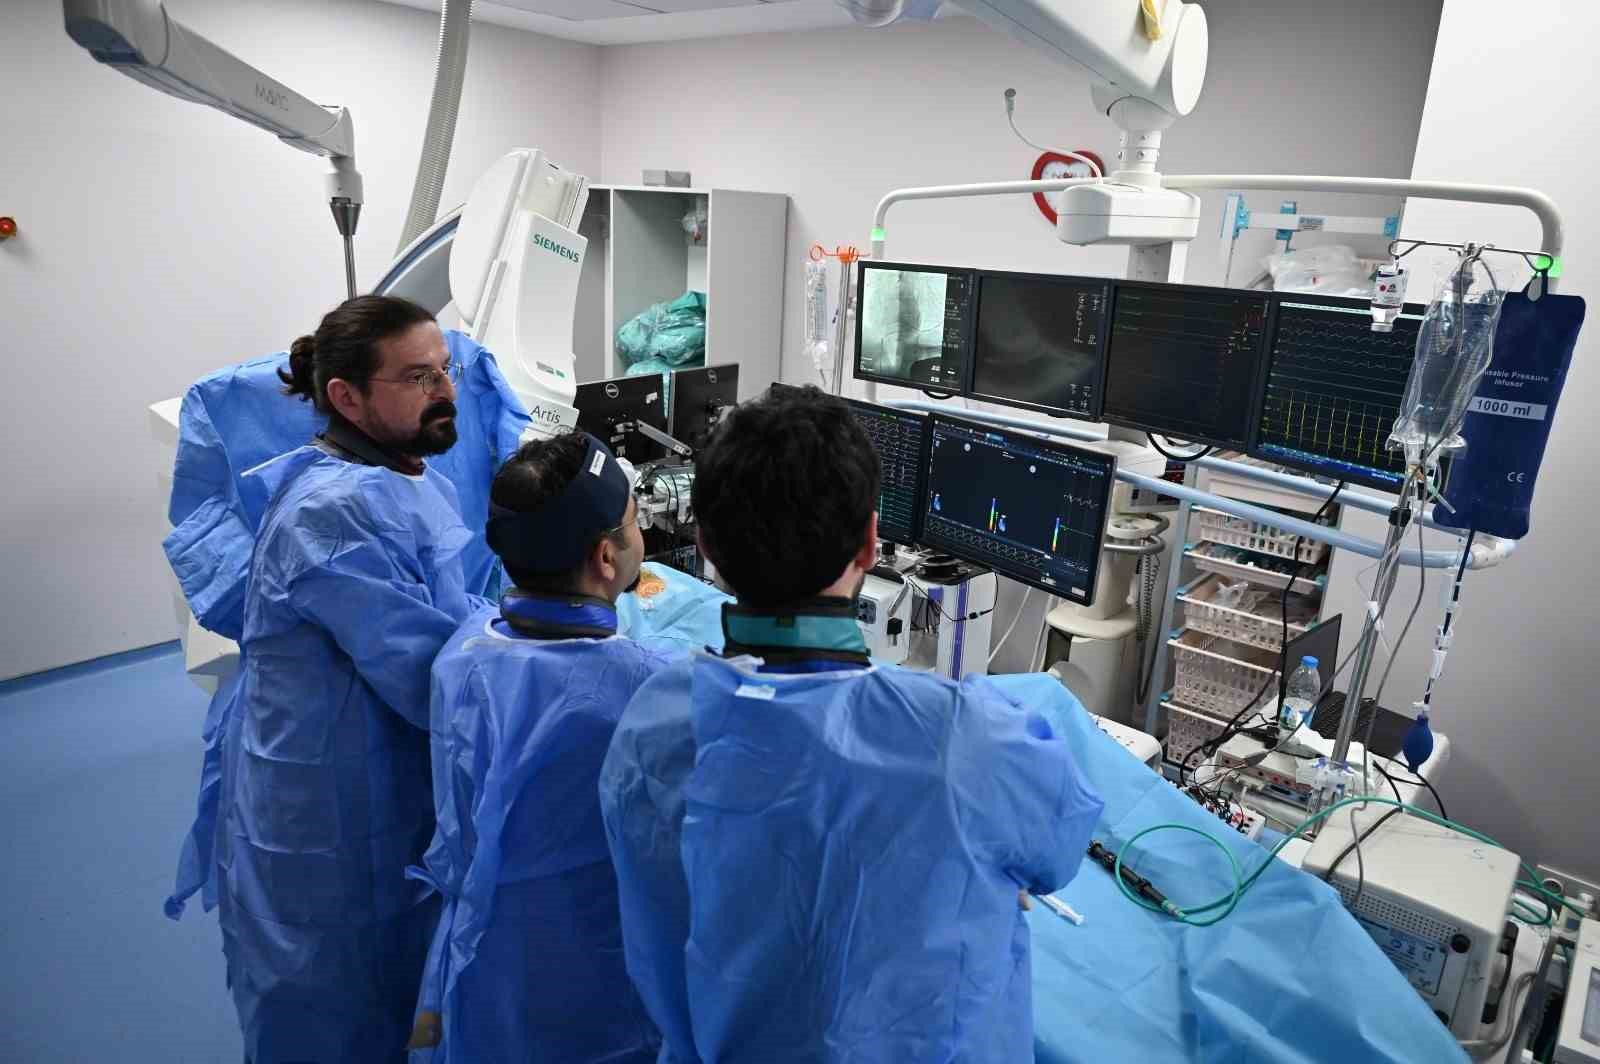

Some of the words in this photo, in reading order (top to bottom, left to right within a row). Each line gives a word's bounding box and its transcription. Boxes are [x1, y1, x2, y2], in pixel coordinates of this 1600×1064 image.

[533, 234, 580, 263] SIEMENS
[1511, 370, 1549, 382] Pressure
[530, 405, 561, 424] Artis
[1477, 399, 1509, 413] 1000
[1513, 405, 1531, 416] ml
[1507, 471, 1525, 483] CE
